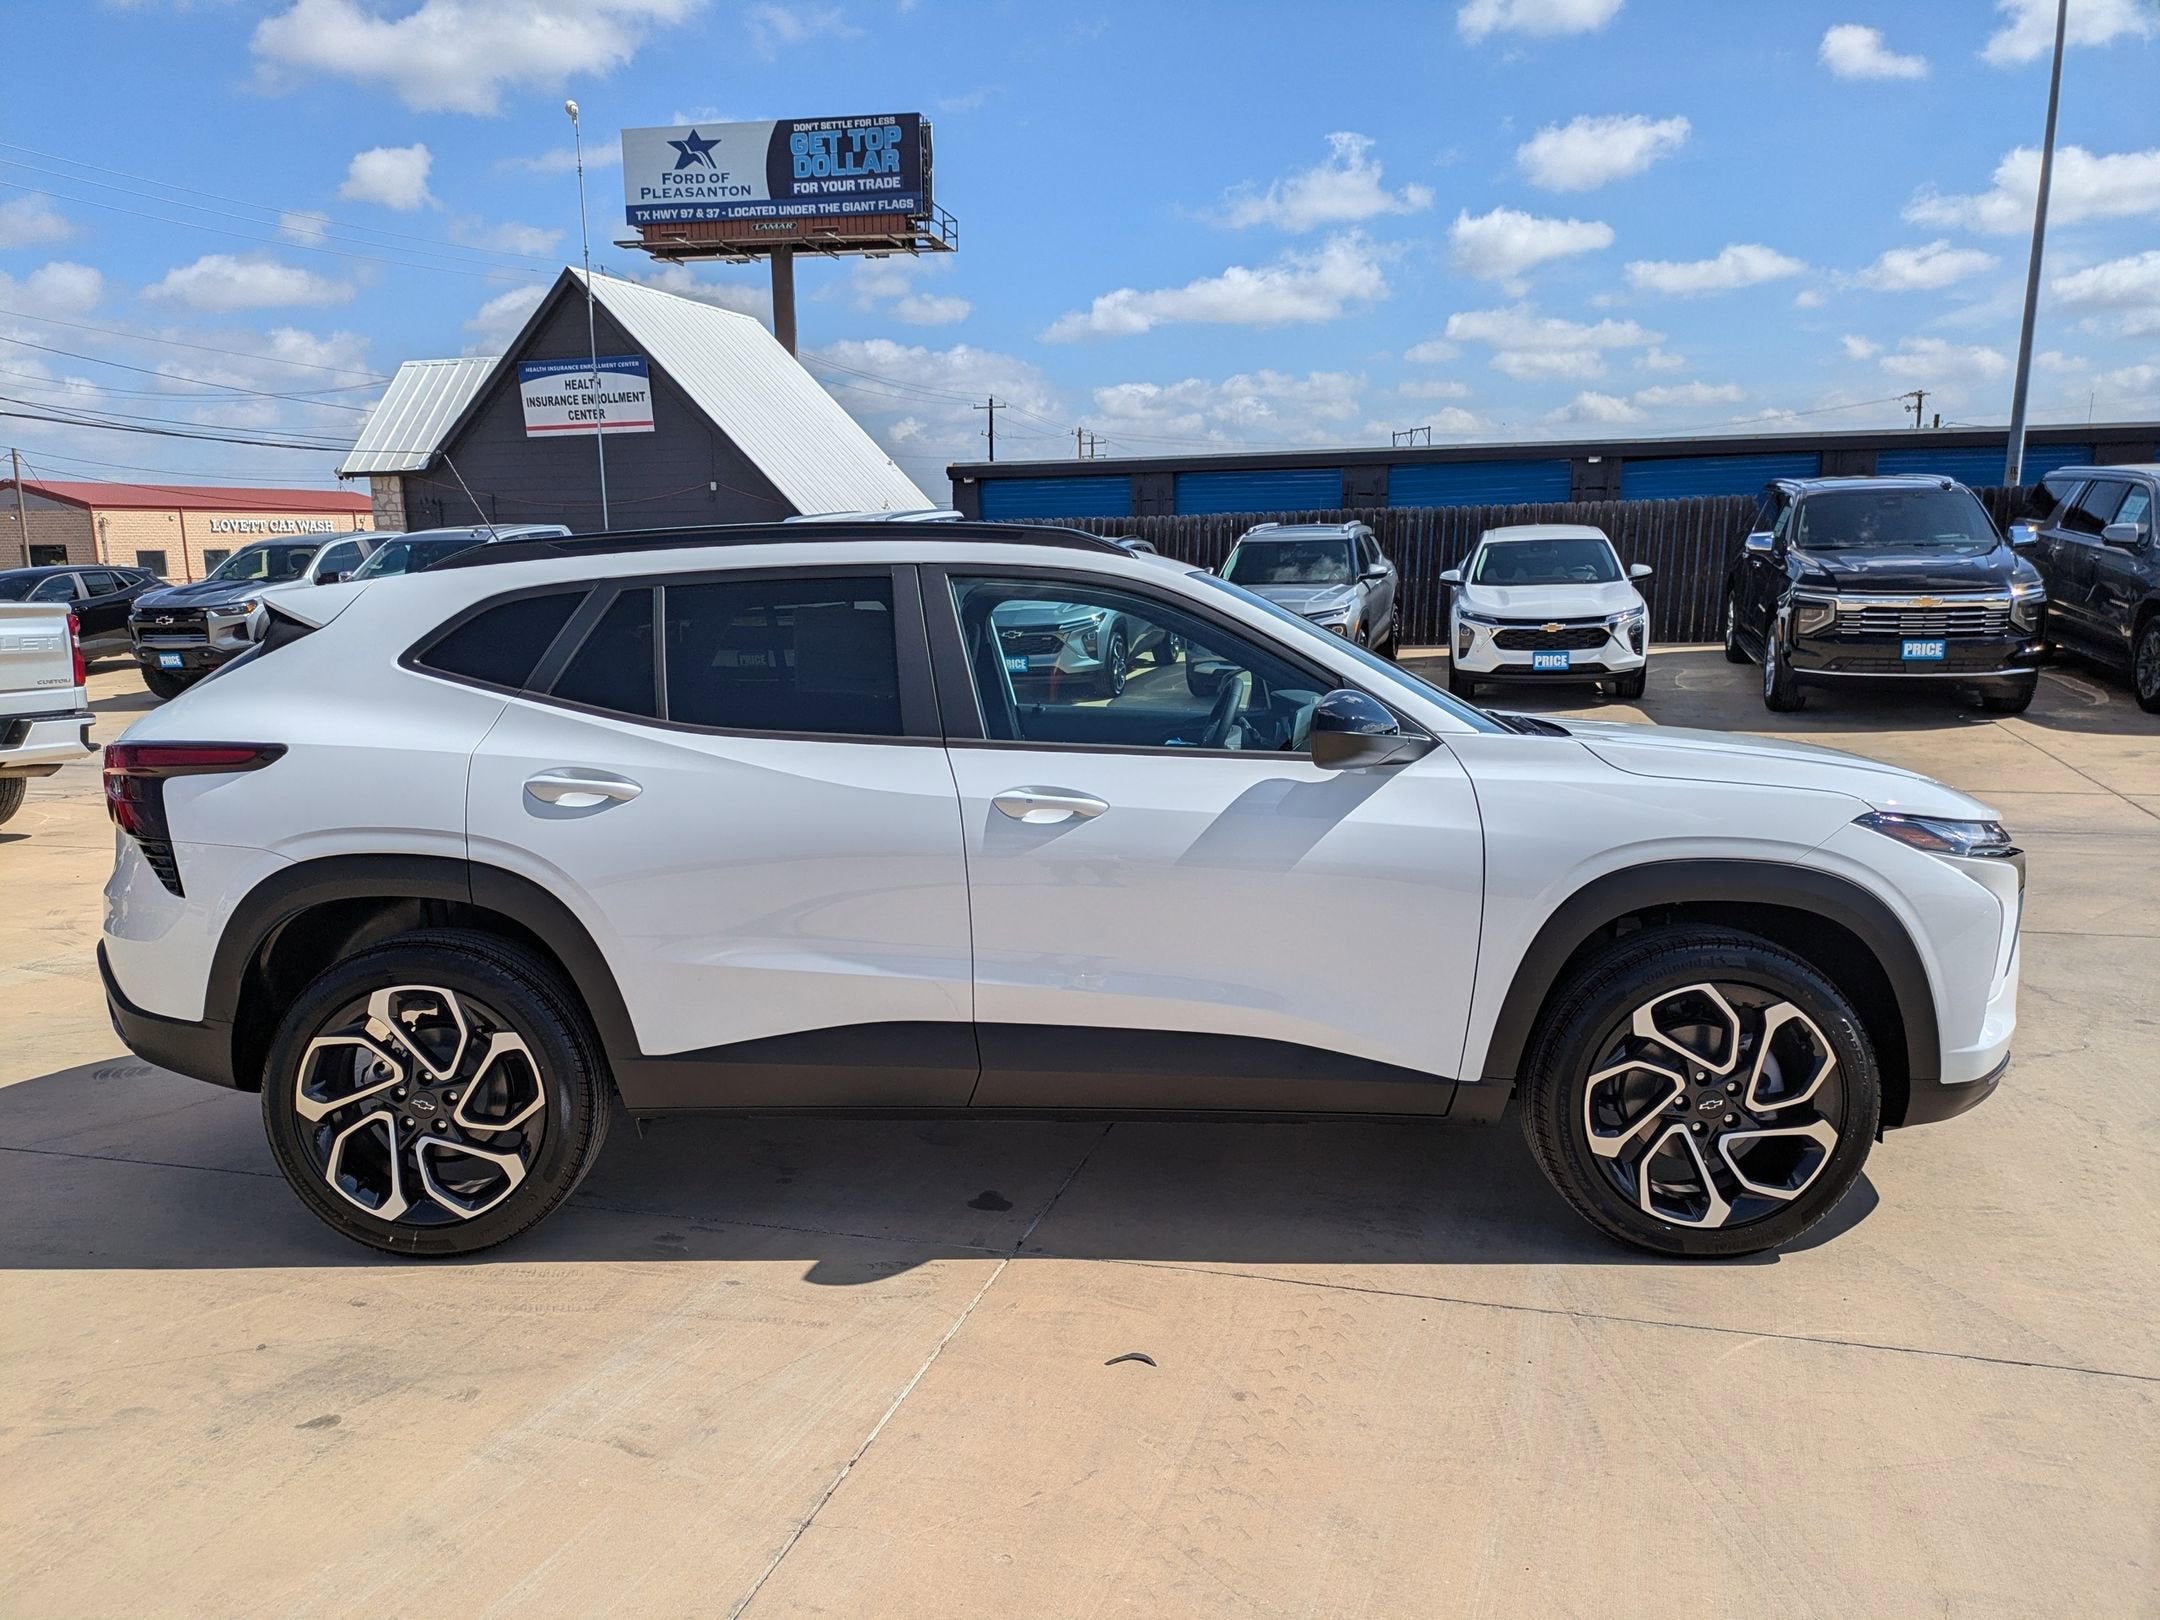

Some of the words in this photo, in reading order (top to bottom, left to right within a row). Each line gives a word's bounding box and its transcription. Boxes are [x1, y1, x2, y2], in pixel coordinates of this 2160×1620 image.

[793, 123, 819, 132] DON'T
[821, 120, 853, 130] SETTLE
[855, 119, 872, 128] FOR
[874, 117, 895, 125] LESS
[790, 130, 842, 155] GET
[847, 125, 902, 152] TOP
[793, 149, 900, 178] DOLLAR
[662, 172, 705, 185] FORD
[709, 172, 730, 183] OF
[793, 182, 818, 194] FOR
[821, 180, 855, 192] YOUR
[858, 177, 901, 190] TRADE
[640, 185, 751, 199] PLEASANTON
[636, 211, 651, 220] TX
[652, 209, 678, 219] HWY
[680, 209, 694, 218] 97
[696, 209, 704, 218] &
[706, 208, 720, 218] 37
[728, 206, 776, 217] LOCATED
[779, 204, 816, 215] UNDER
[818, 203, 840, 213] THE
[842, 201, 876, 212] GIANT
[878, 199, 914, 209] FLAGS
[755, 222, 793, 231] LAMAR
[565, 378, 602, 390] HEALTH
[526, 394, 579, 407] INSURANCE
[568, 409, 606, 421] CENTER
[210, 519, 266, 533] LOVETT
[268, 519, 295, 533] CAR
[296, 520, 335, 534] WASH
[1903, 642, 1944, 657] PRICE
[1005, 659, 1027, 670] RICE
[1535, 655, 1568, 668] PRICE
